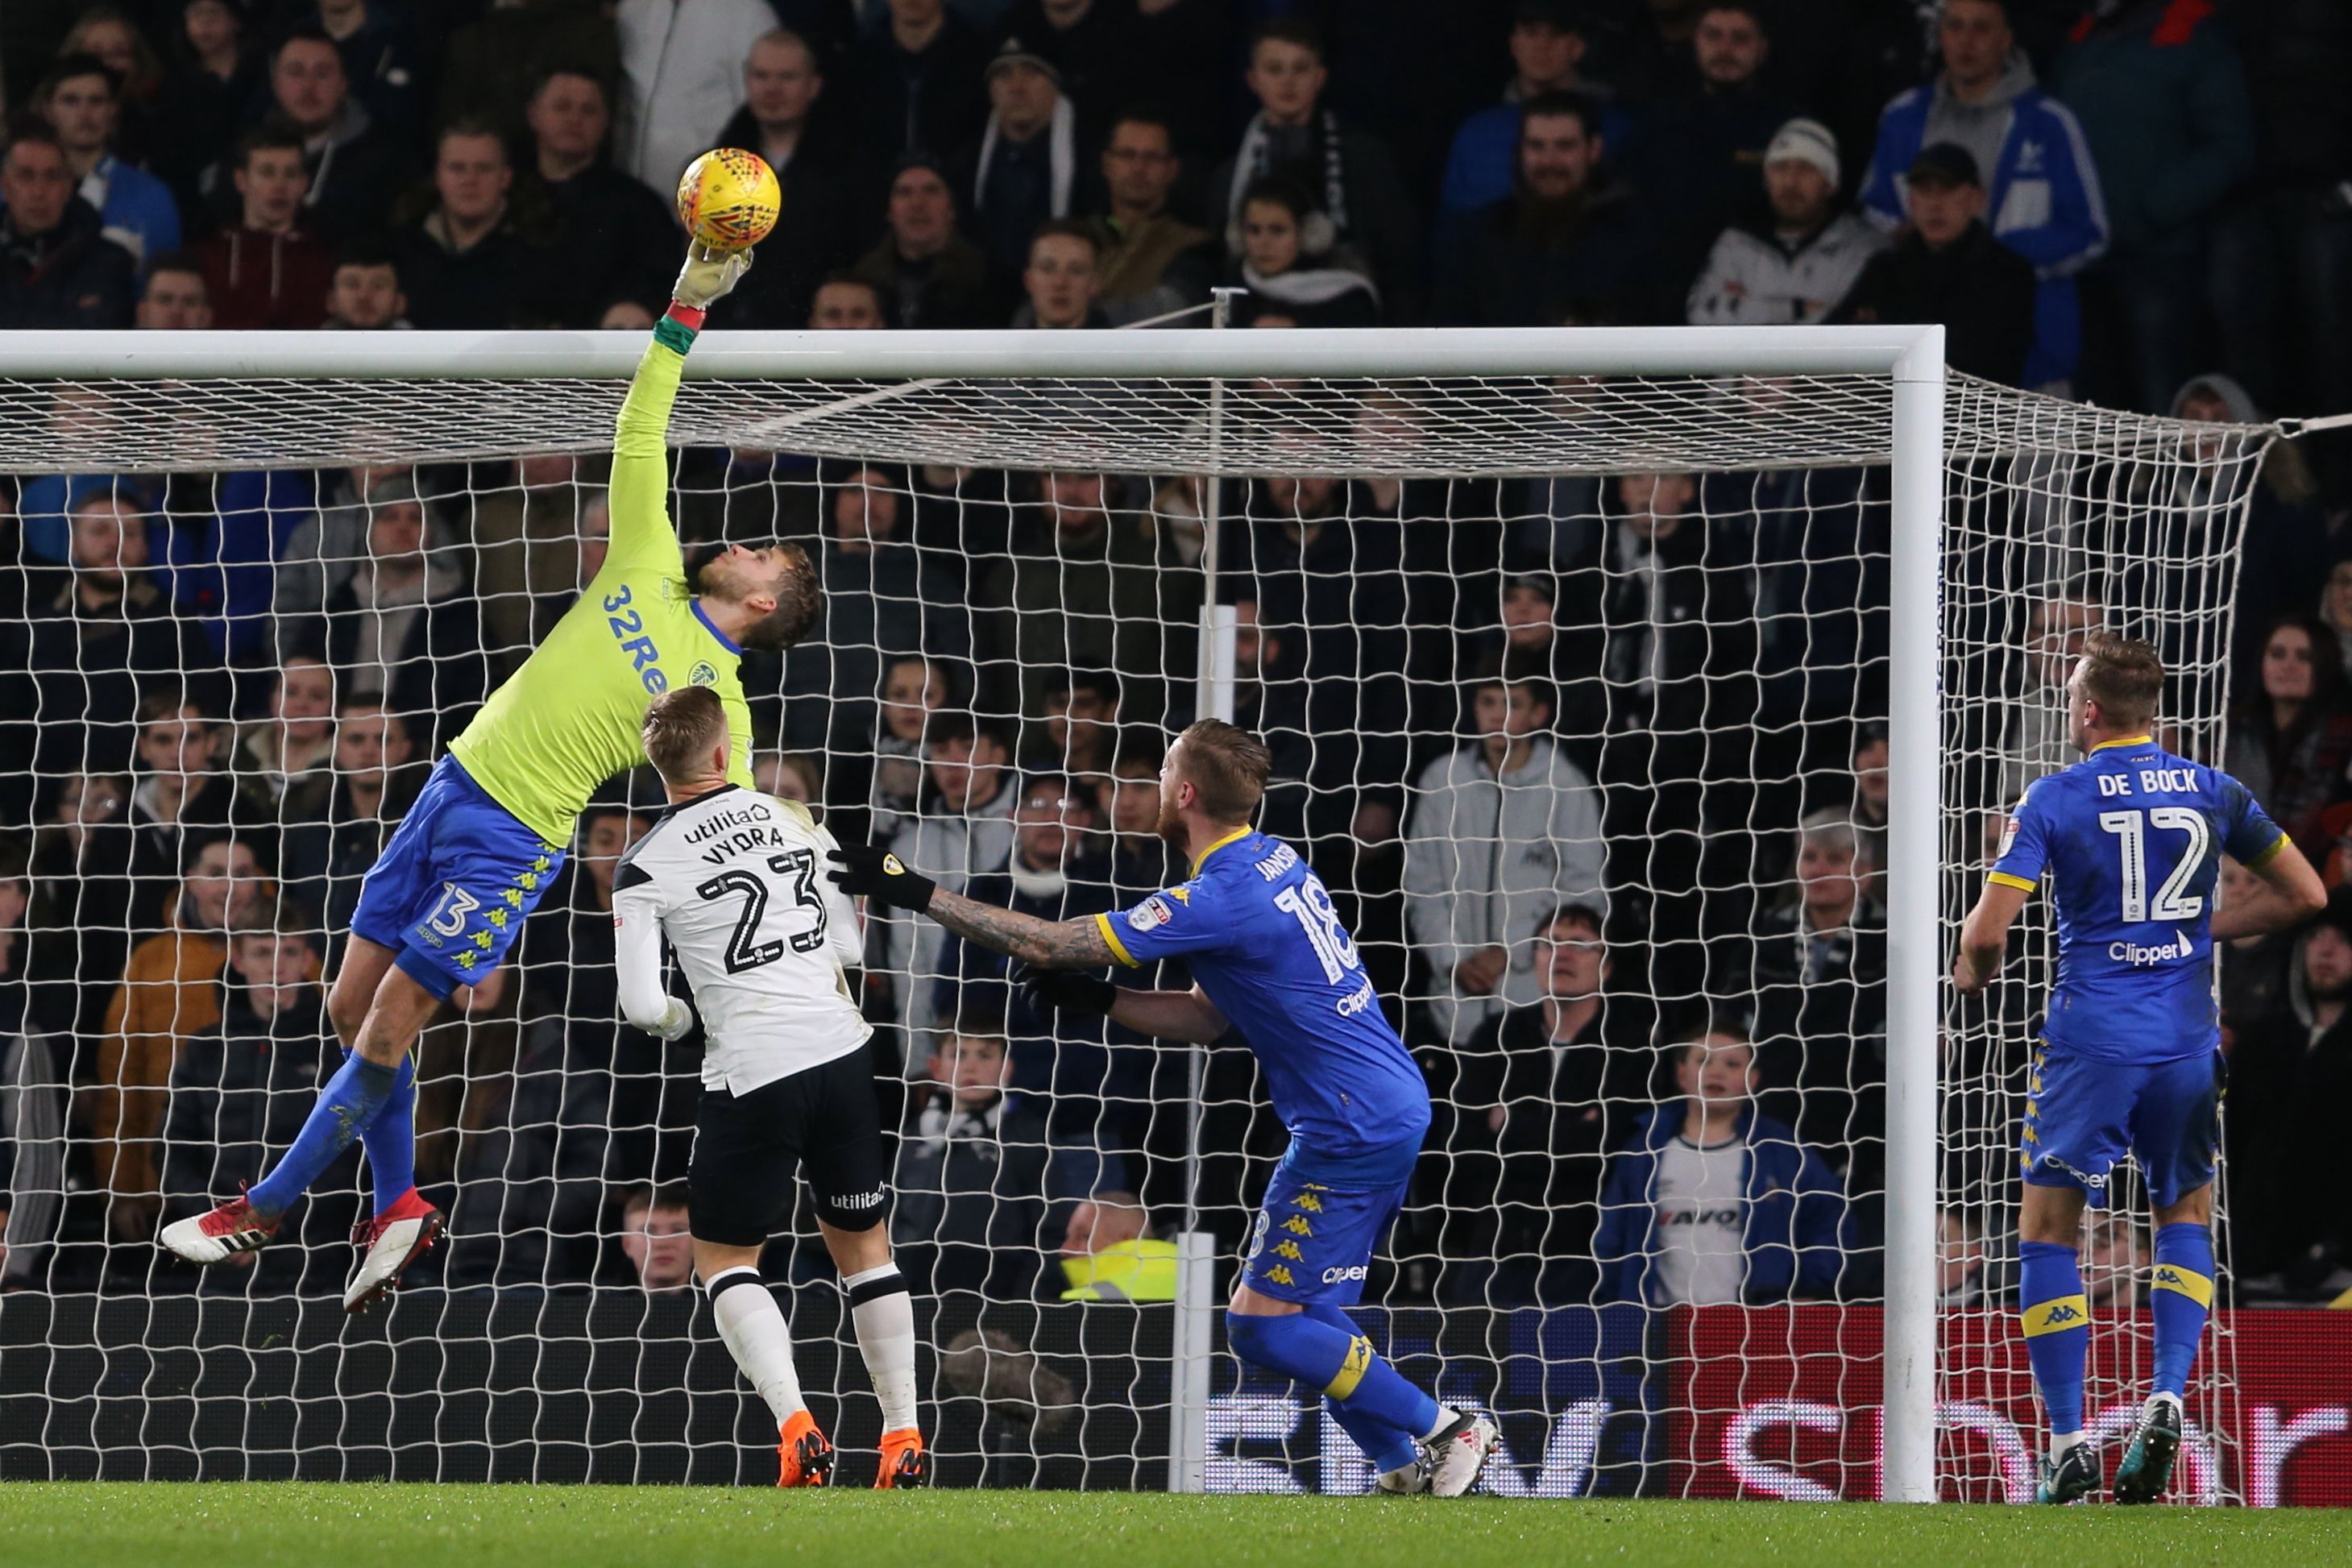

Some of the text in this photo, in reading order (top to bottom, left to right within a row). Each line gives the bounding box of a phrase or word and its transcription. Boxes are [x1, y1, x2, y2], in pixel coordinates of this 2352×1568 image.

[2097, 768, 2200, 797] DE BOCK
[683, 809, 753, 844] utilita
[701, 827, 784, 865] VYDRA
[2099, 807, 2209, 923] 12
[425, 881, 481, 937] 13
[695, 848, 828, 976] 23
[1273, 872, 1359, 986] 18
[2108, 941, 2178, 966] Clipper
[830, 1191, 880, 1210] utilita
